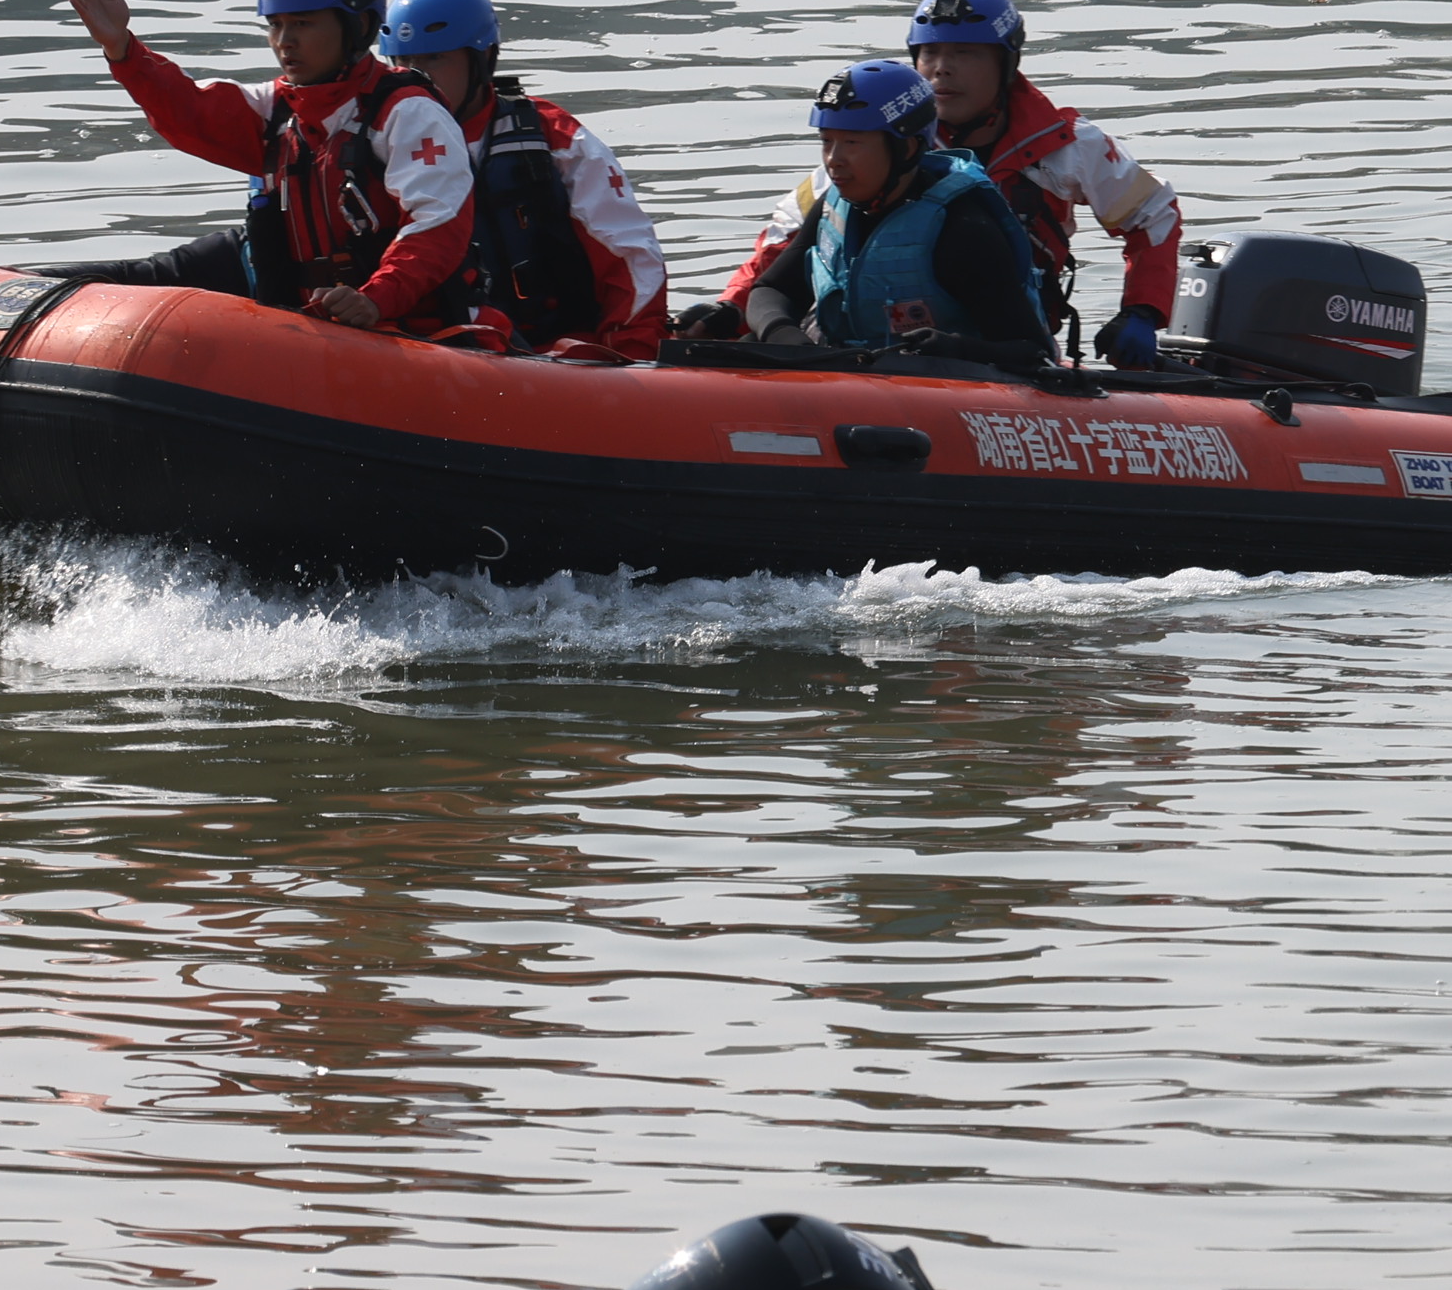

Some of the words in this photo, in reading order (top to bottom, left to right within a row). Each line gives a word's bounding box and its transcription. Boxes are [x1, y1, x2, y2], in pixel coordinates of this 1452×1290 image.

[1178, 277, 1208, 298] 30
[1350, 298, 1415, 334] YAMAHA
[959, 410, 1249, 482] 湖南省红十字蓝天救援队
[1404, 458, 1440, 472] ZHAO
[1411, 475, 1445, 491] BOAT
